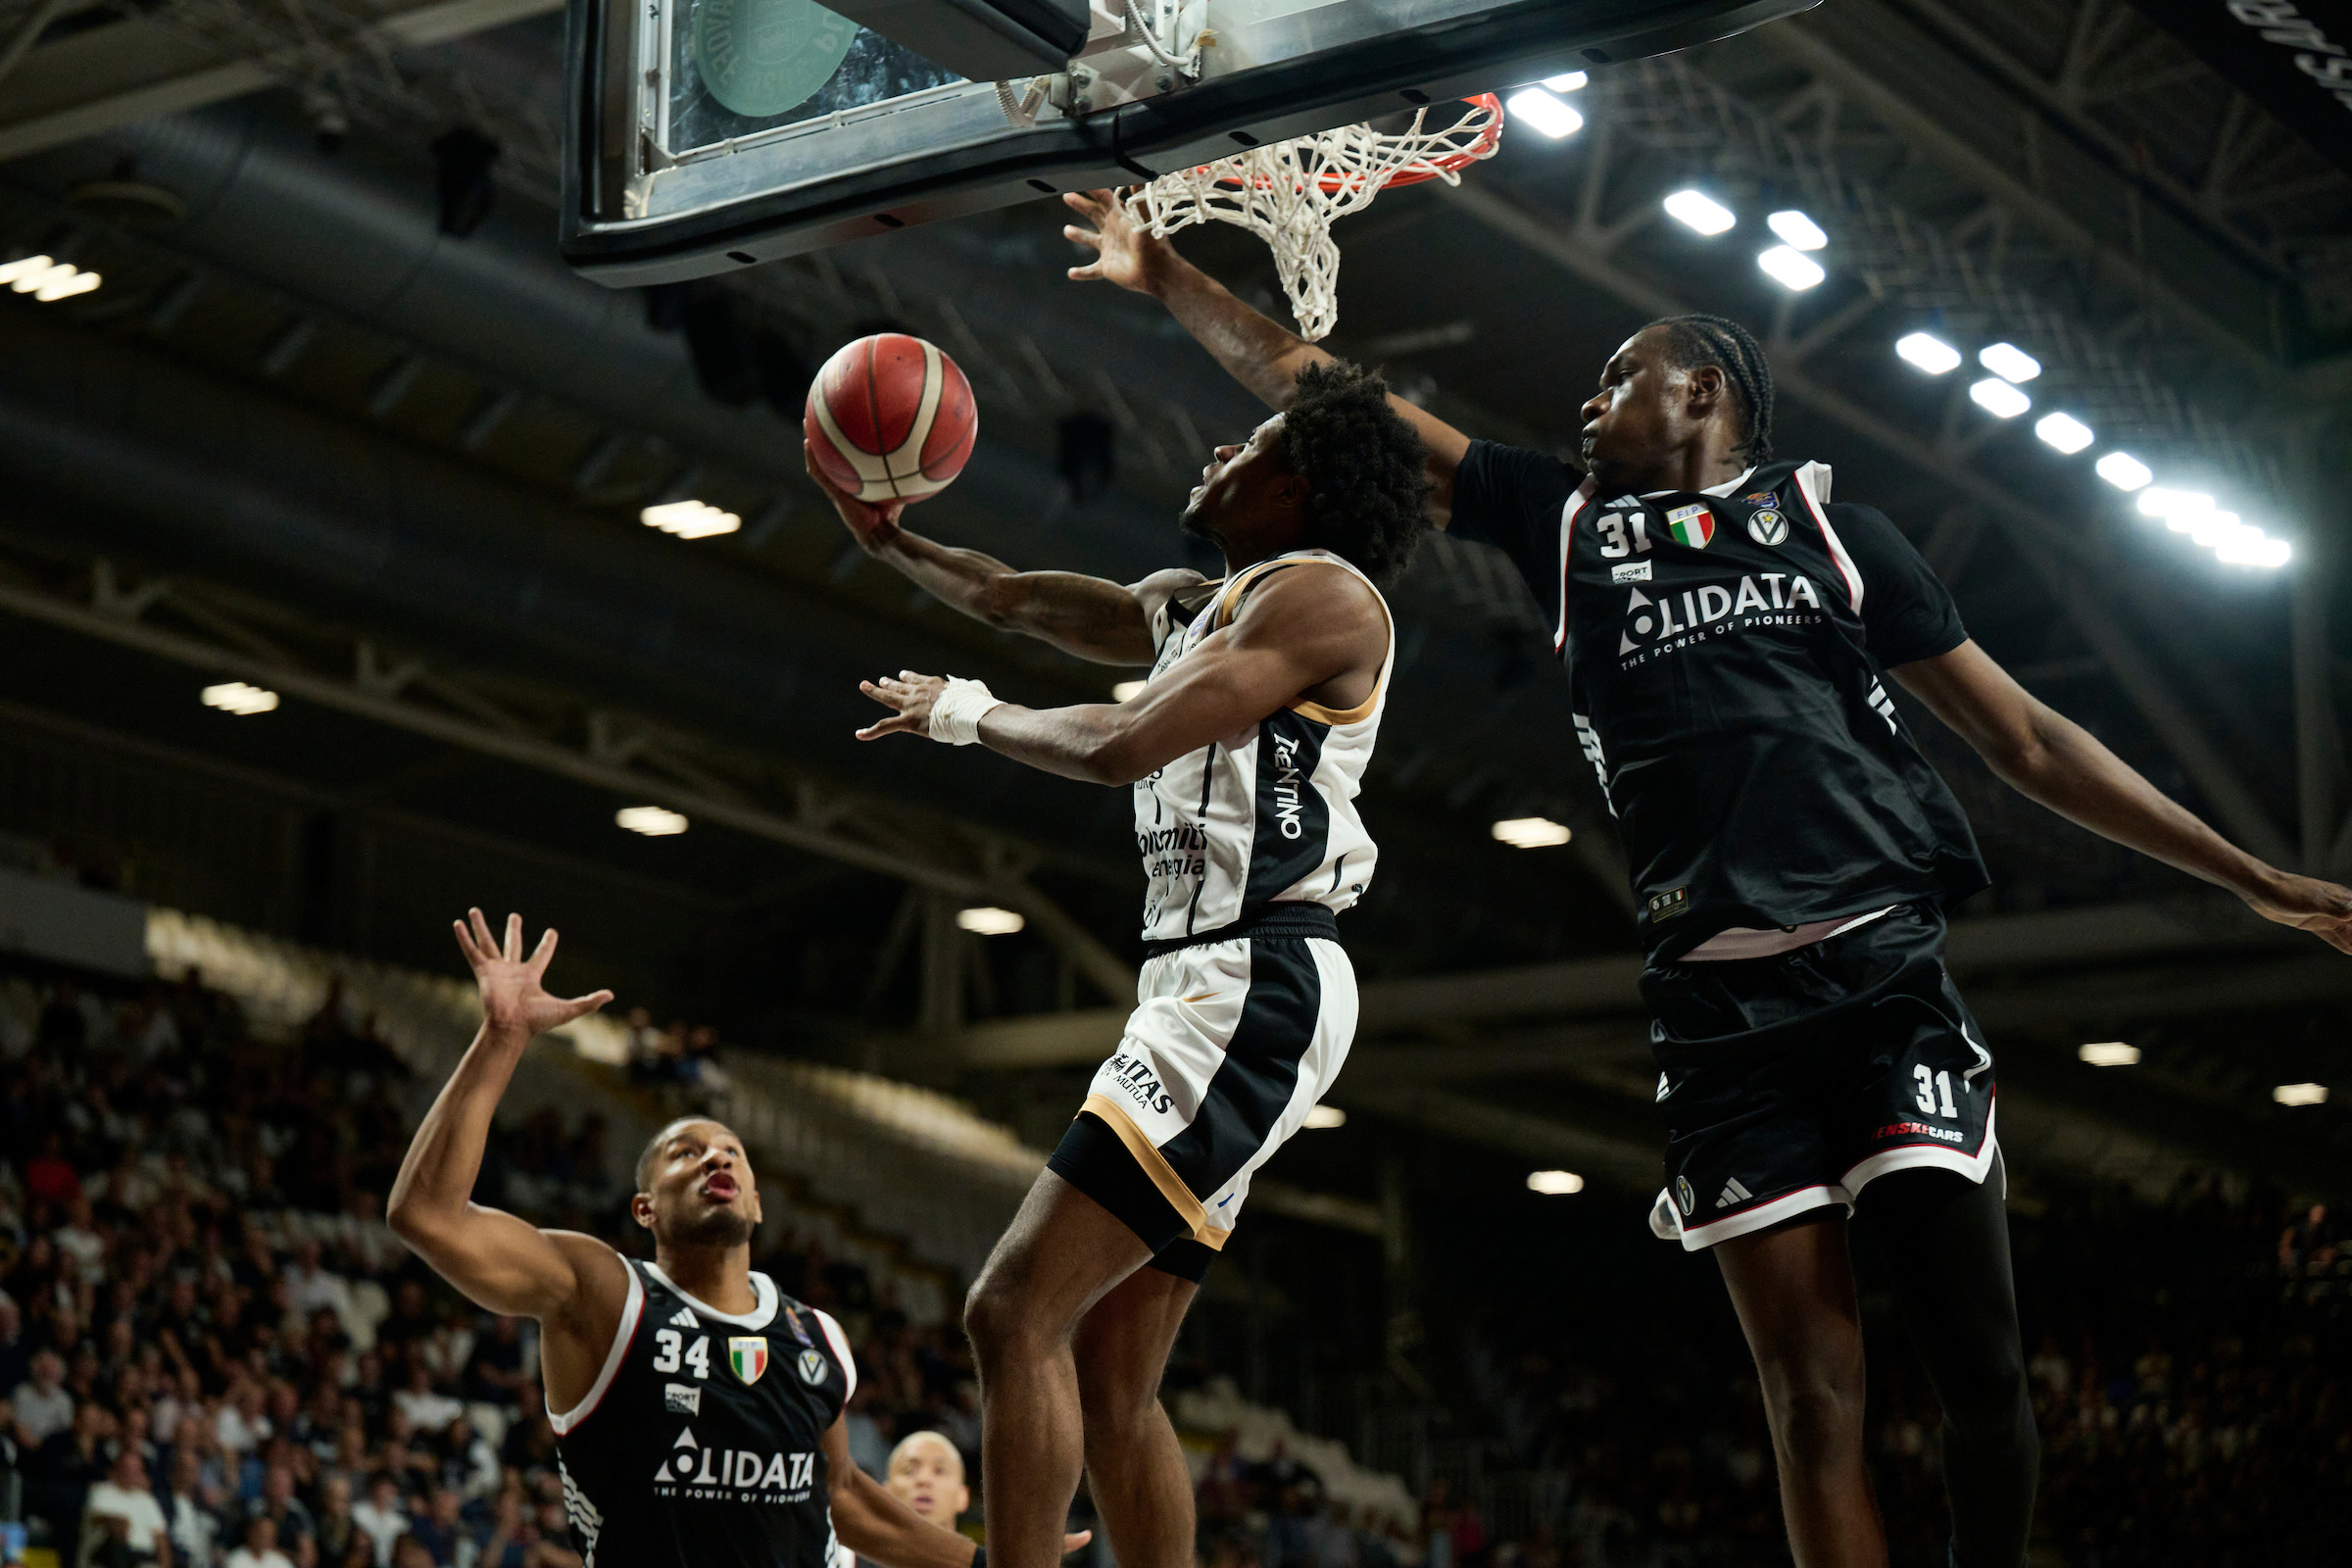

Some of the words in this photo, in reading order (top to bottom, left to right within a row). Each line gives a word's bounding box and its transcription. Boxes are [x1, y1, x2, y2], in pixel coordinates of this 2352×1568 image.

[1596, 512, 1652, 558] 31
[1677, 507, 1698, 519] FIP
[1621, 654, 1646, 671] THE
[1654, 632, 1706, 658] POWER
[1715, 621, 1735, 635] OF
[1744, 614, 1822, 627] PIONEERS
[1113, 1075, 1148, 1109] MUTUA
[1123, 1058, 1175, 1114] ITAS
[1913, 1063, 1958, 1118] 31
[653, 1328, 710, 1379] 34
[654, 1487, 677, 1496] THE
[686, 1488, 732, 1500] POWER
[741, 1492, 758, 1502] OF
